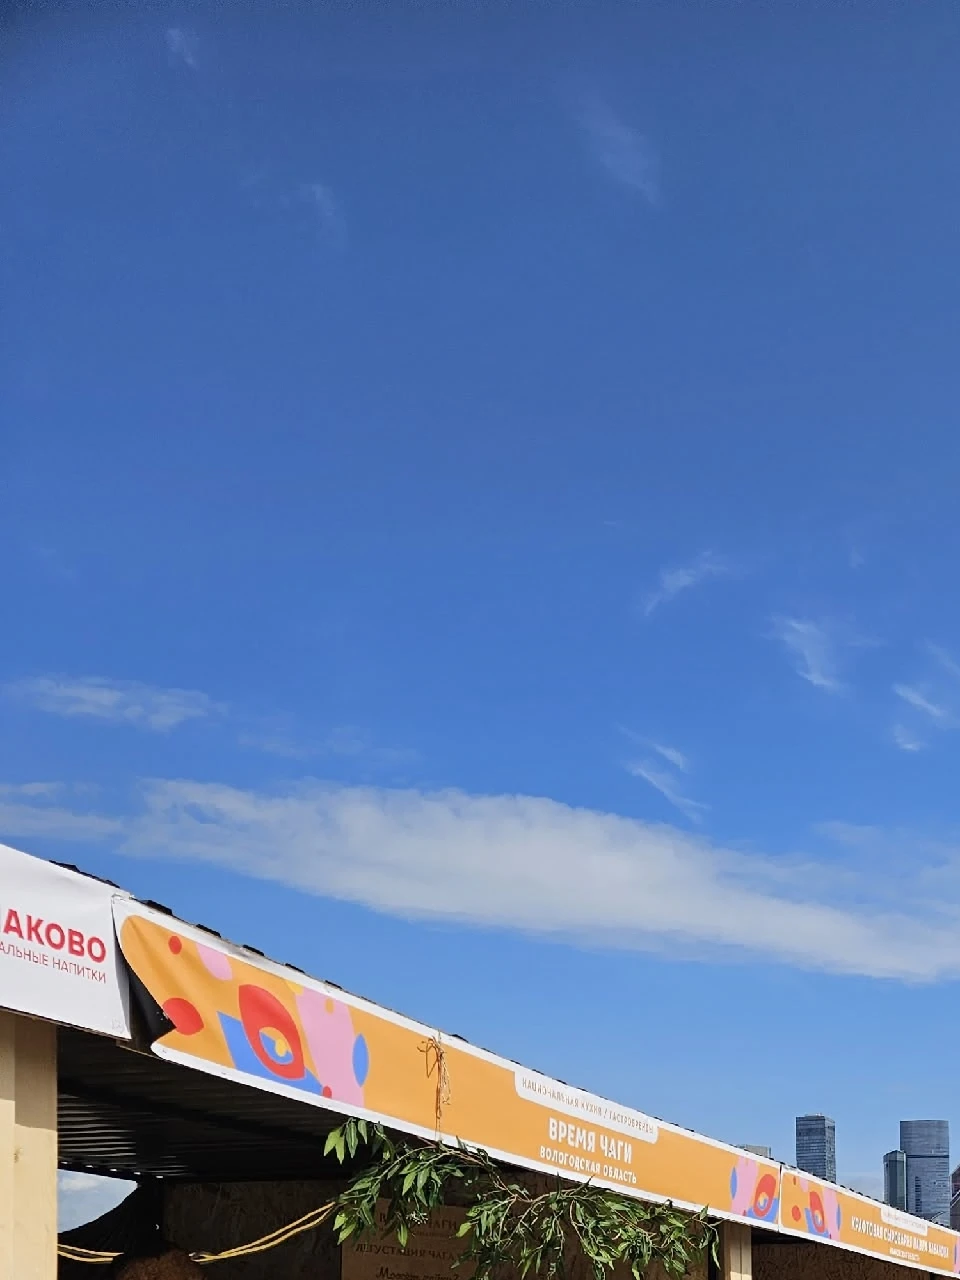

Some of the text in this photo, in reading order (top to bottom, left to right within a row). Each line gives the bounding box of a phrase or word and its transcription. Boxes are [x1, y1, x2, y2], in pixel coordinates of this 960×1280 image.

[3, 908, 107, 963] АКОВО
[0, 941, 107, 984] АЛЬНЫЕ НАПИТКИ
[521, 1077, 579, 1107] НАЦИОНАЛЬНАЯ
[581, 1101, 602, 1117] КУХНЯ
[609, 1111, 655, 1134] ГАСТРОБРЕНДЫ
[540, 1145, 638, 1184] ВОЛОГОДСКАЯ ОБЛАСТЬ
[548, 1116, 633, 1165] ВРЕМЯ ЧАГИ
